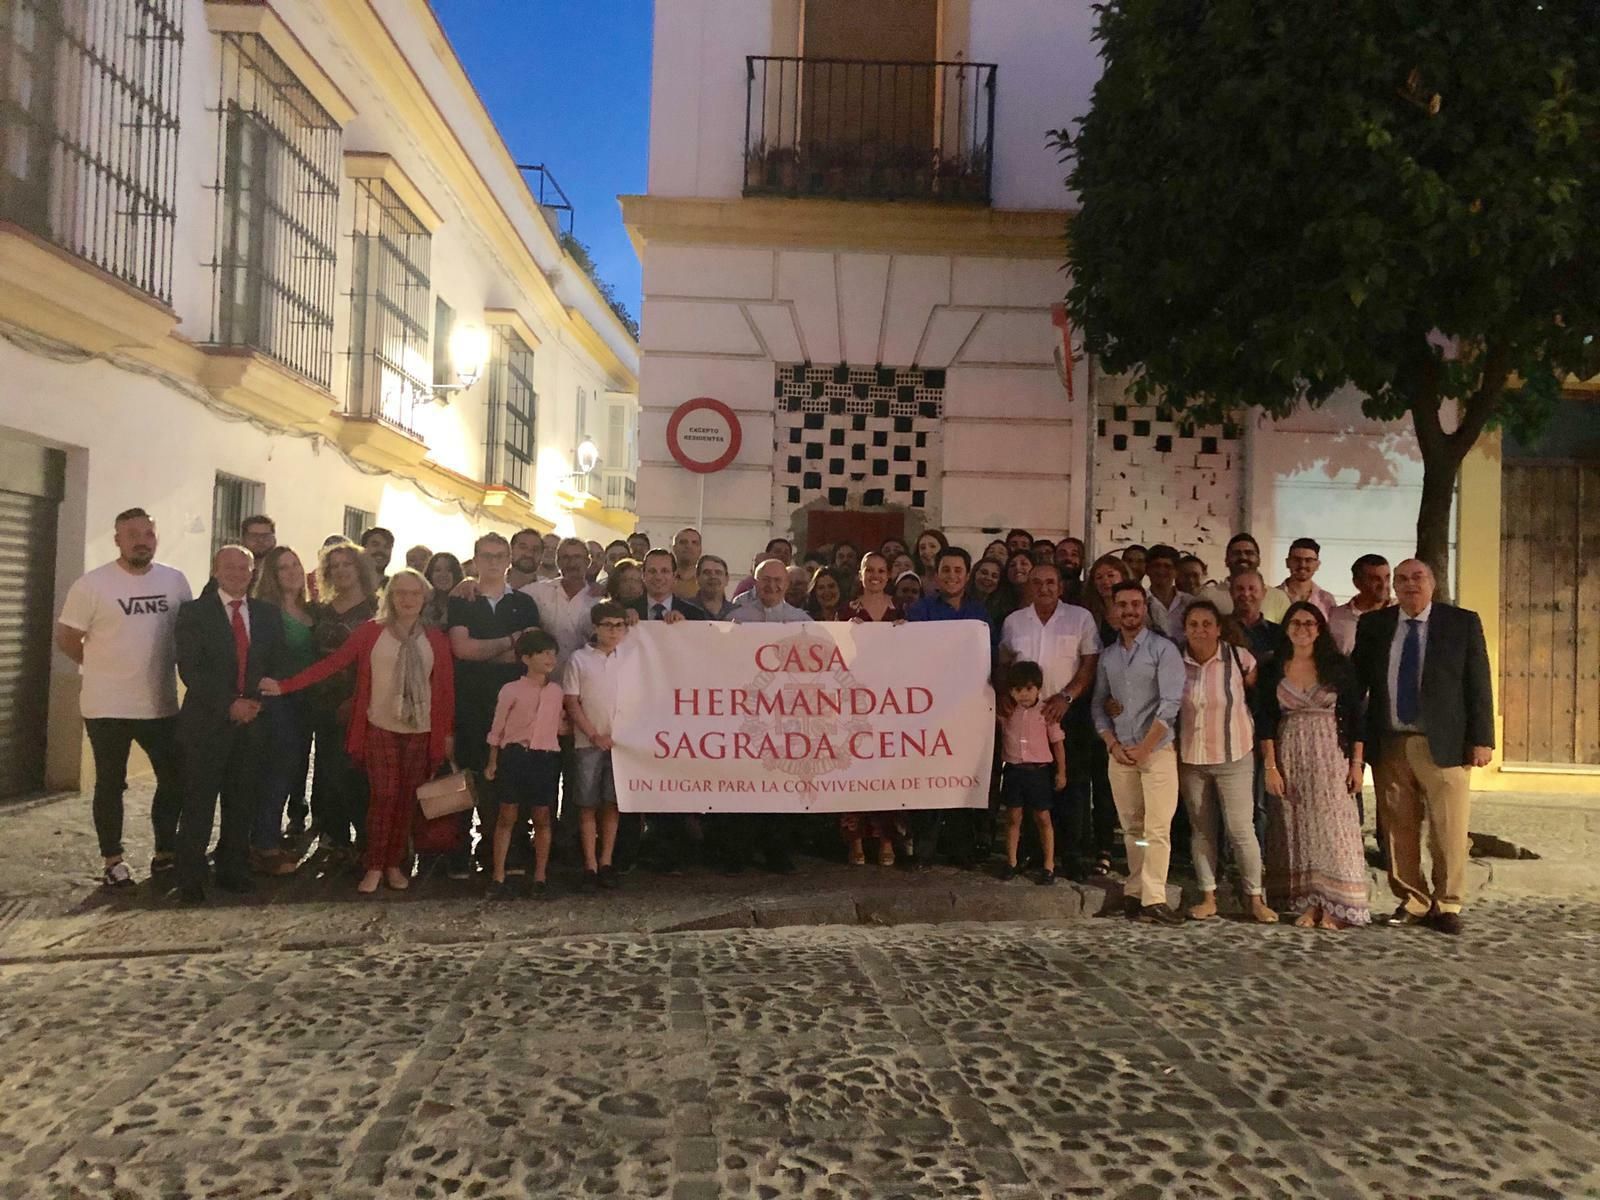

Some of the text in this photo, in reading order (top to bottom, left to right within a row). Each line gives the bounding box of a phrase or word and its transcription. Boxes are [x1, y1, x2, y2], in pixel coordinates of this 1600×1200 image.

[117, 595, 168, 615] VANS
[755, 644, 849, 672] CASA
[674, 687, 933, 716] HERMANDAD
[654, 728, 953, 759] SAGRADA CENA
[629, 775, 981, 792] UN LUGAR PARA LA CONVIVENCIA DE TODOS
